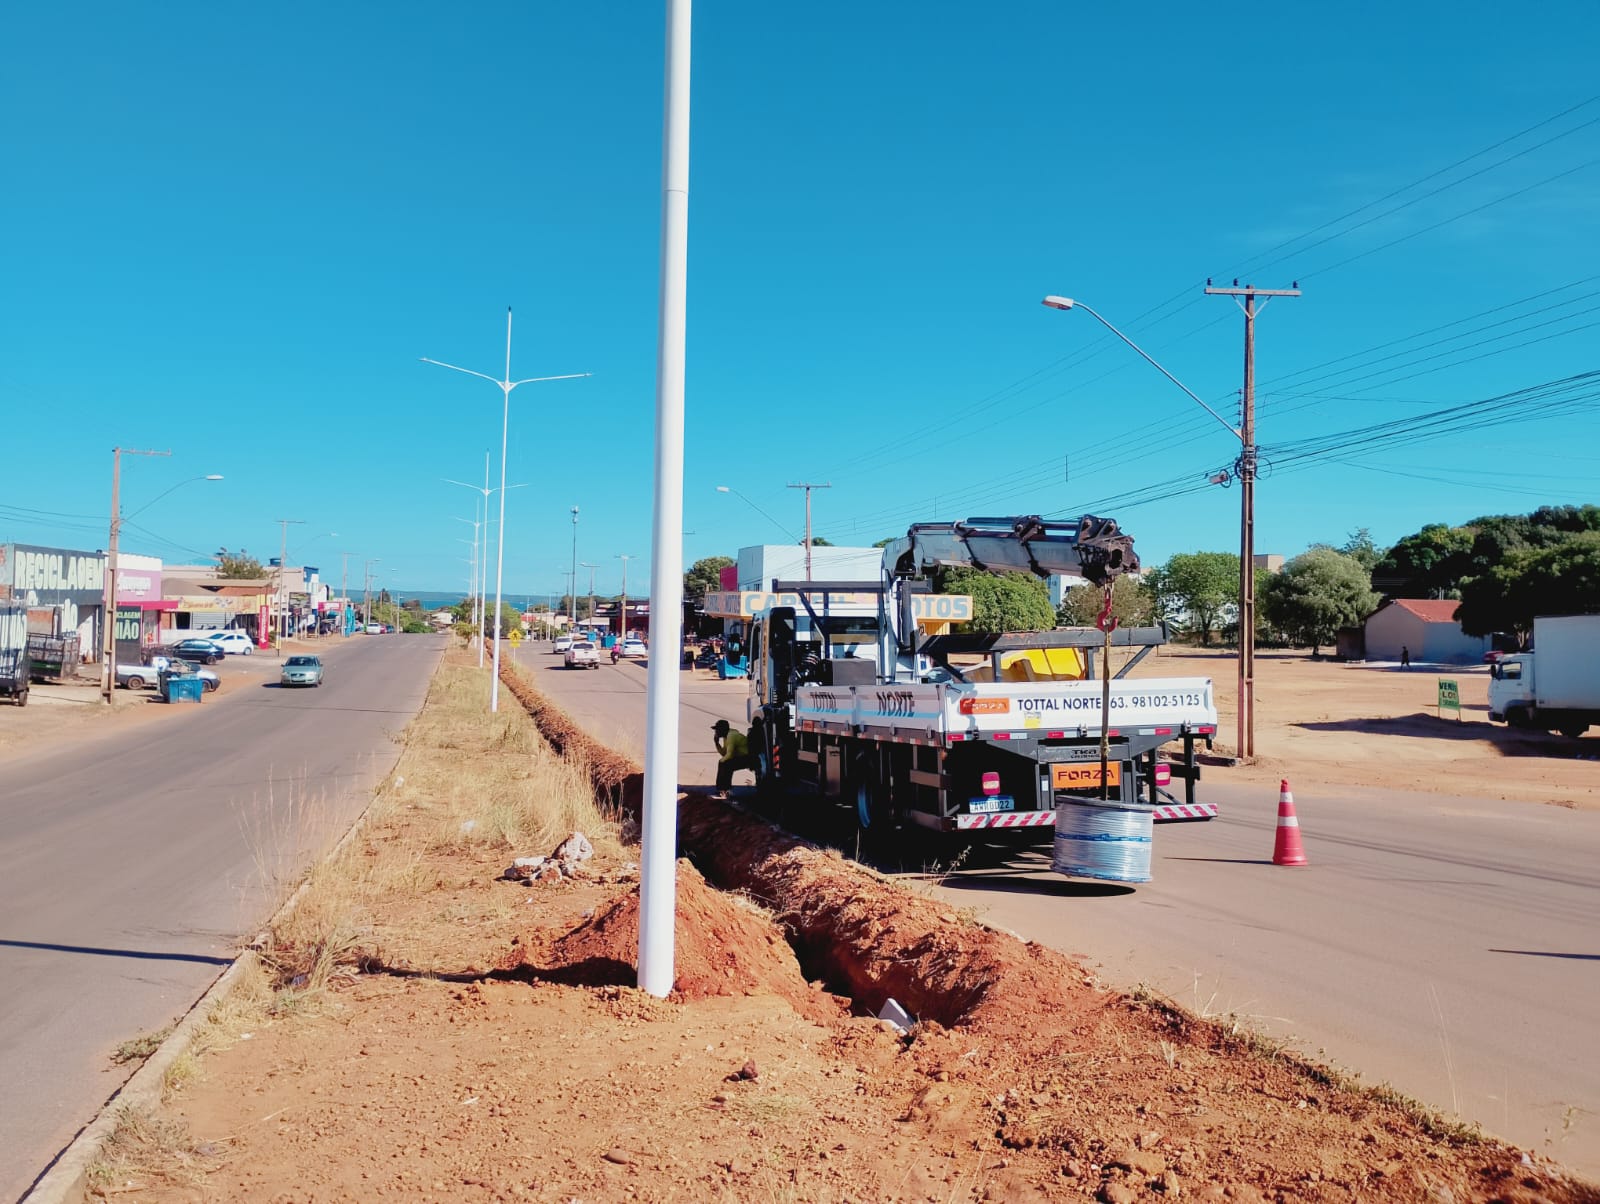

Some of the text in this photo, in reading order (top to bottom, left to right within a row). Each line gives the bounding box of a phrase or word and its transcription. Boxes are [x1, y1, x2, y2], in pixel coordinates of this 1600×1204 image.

[15, 551, 104, 589] RECICLAGEM
[1017, 694, 1200, 711] TOTTAL NORTE 63. 98102-5125
[1057, 769, 1114, 781] FORZA
